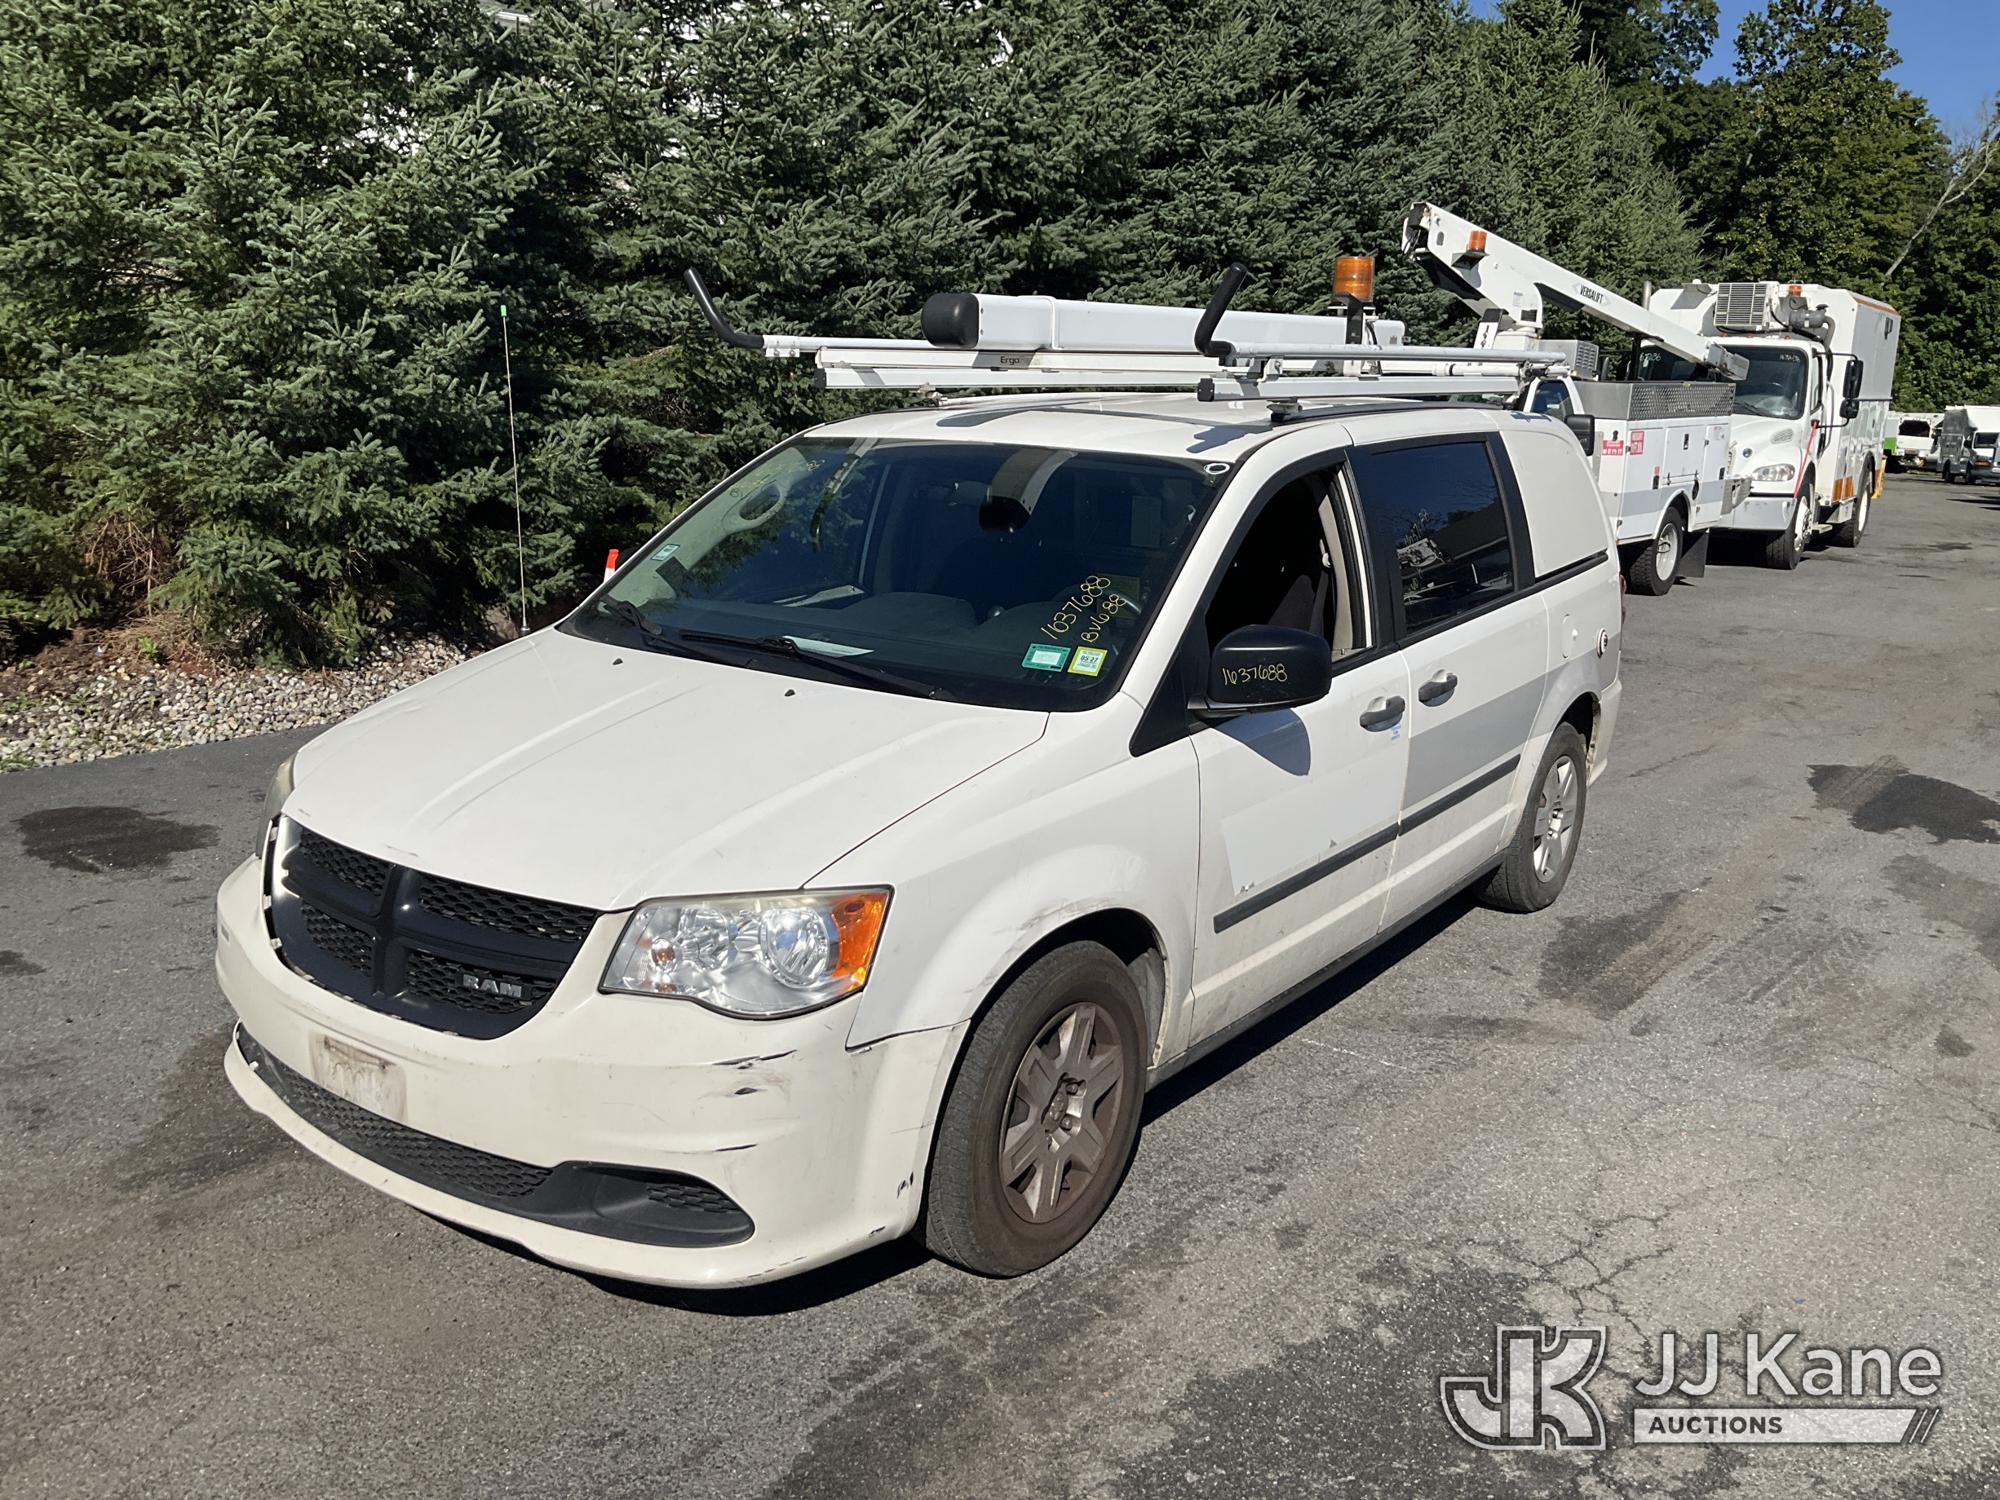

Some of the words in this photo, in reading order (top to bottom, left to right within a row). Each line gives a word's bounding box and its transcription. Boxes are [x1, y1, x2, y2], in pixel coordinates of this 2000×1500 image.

[1040, 575, 1111, 640] 1637688
[1222, 663, 1288, 686] 1637688
[463, 974, 522, 998] RAM
